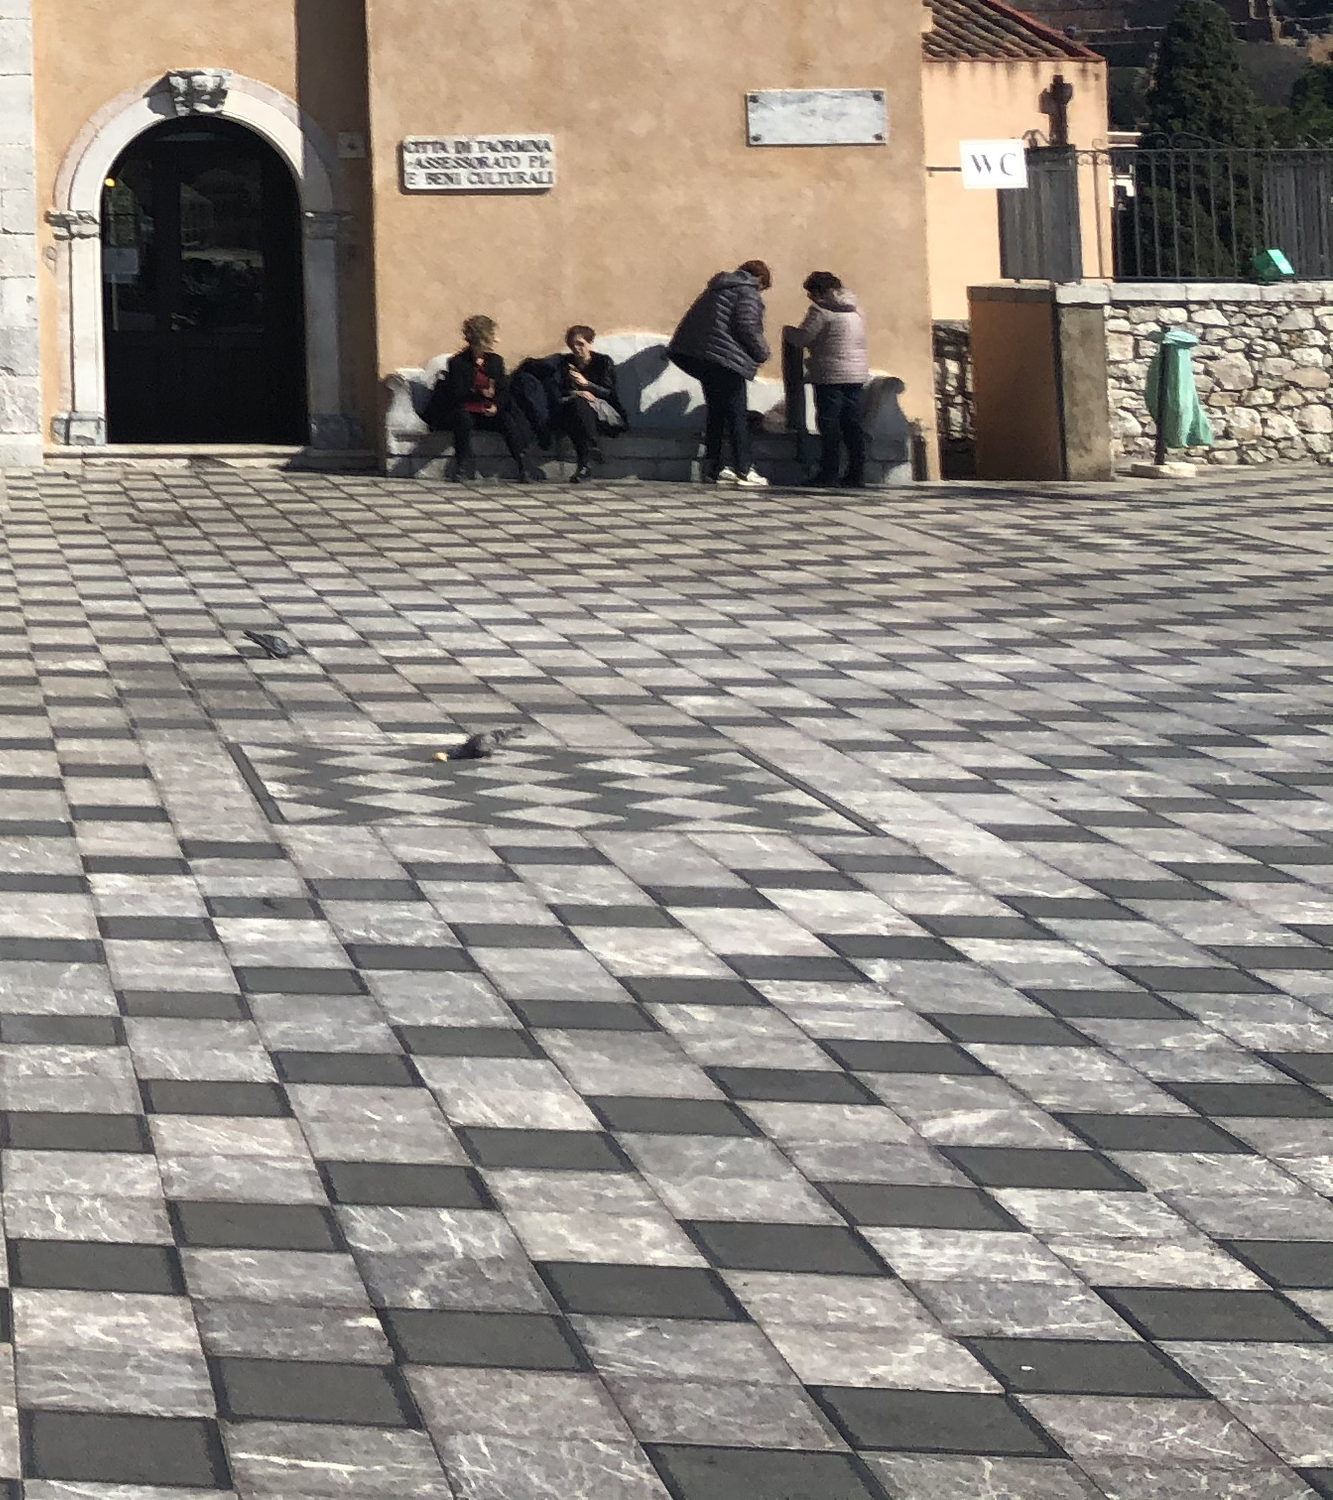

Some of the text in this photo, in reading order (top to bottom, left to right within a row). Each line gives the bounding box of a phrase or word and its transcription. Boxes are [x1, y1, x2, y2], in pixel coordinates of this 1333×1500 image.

[454, 140, 472, 154] DI
[474, 139, 553, 153] TAORMINA
[969, 152, 1017, 176] WC
[405, 171, 554, 185] E BENI CULTURALI
